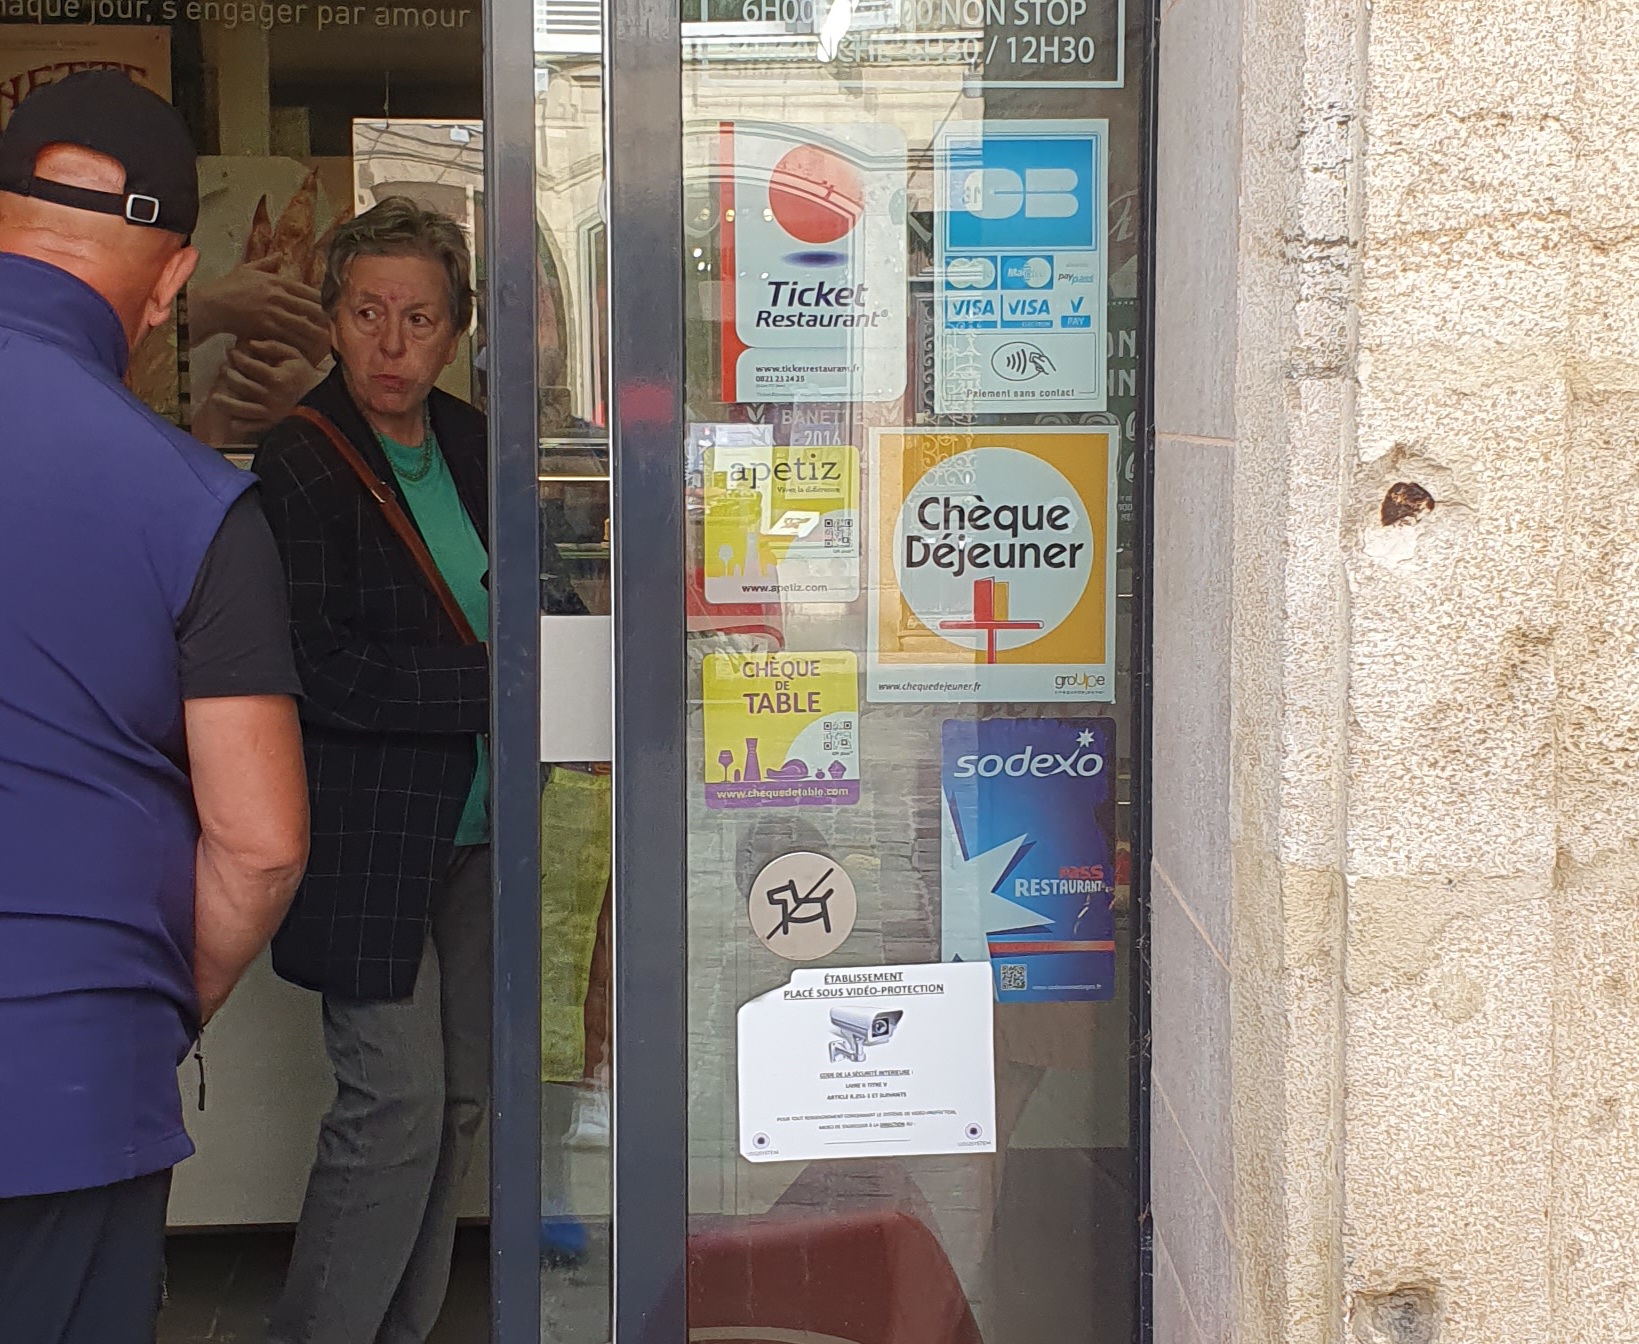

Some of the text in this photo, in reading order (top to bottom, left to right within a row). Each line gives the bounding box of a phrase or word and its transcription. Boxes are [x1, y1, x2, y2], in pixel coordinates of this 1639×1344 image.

[317, 4, 366, 31] par
[374, 5, 471, 29] amour
[1006, 35, 1095, 64] 12H30
[767, 281, 869, 308] Ticket
[953, 299, 995, 316] VISA
[1008, 299, 1050, 316] VISA
[1066, 316, 1086, 326] PAY
[1039, 388, 1076, 397] contact
[730, 453, 841, 490] apetiz
[917, 494, 1071, 538] Chèque
[905, 533, 1085, 578] Déjeuner
[742, 656, 821, 681] CHÈQUE
[775, 680, 790, 691] DE
[743, 691, 822, 714] TABLE
[953, 745, 1104, 778] sodexo
[1015, 878, 1103, 897] RESTAURANT
[824, 971, 904, 984] ÉTABLISSEMENT
[784, 983, 945, 999] PLACÉ SOUS VIDÉO-PROTECTION
